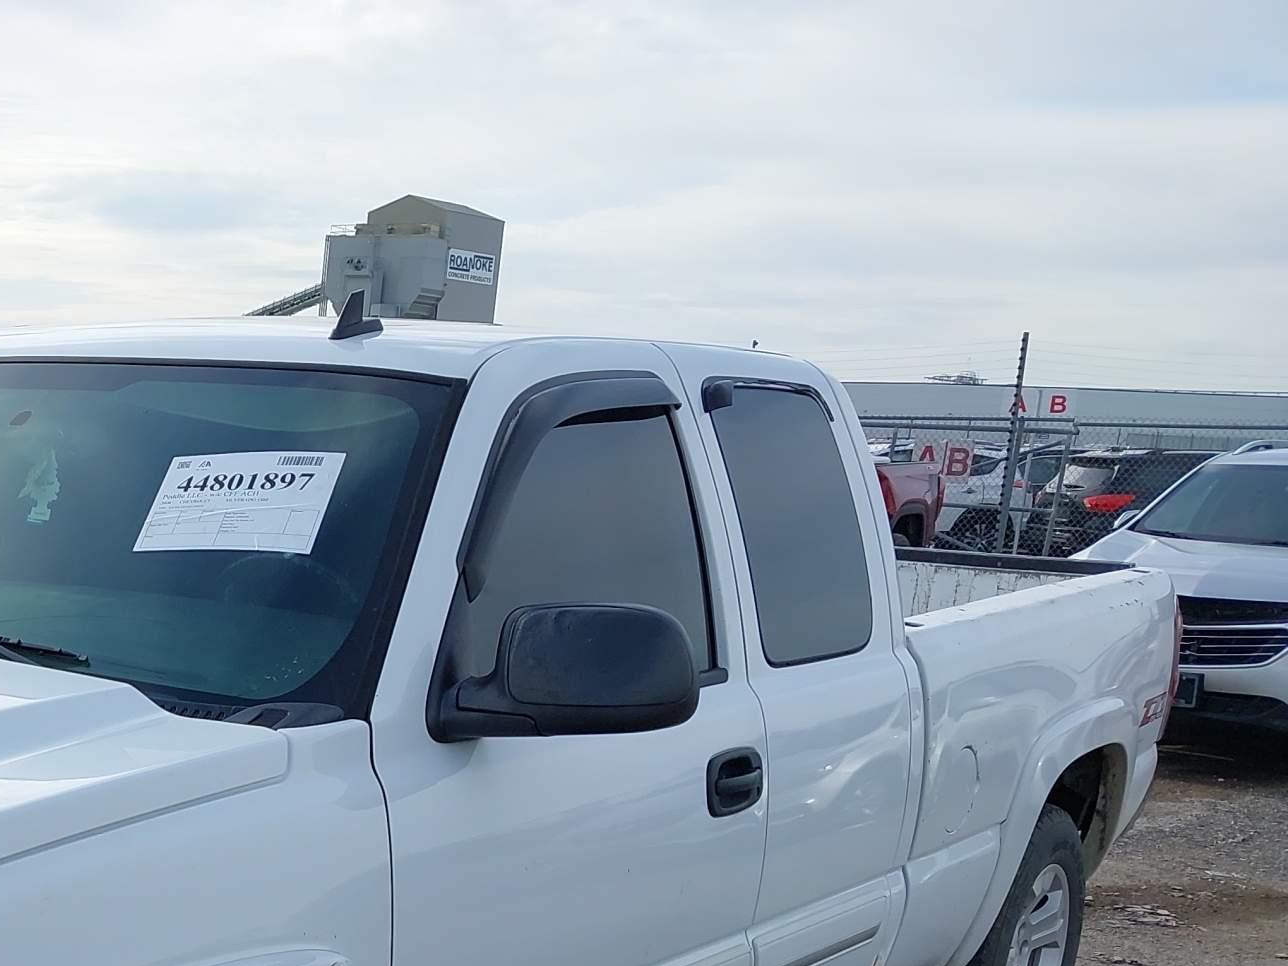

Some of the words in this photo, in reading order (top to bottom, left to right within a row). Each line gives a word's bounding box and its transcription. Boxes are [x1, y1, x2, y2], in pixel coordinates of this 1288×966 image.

[449, 254, 494, 272] ROANOKE
[1008, 395, 1026, 412] A
[1049, 395, 1067, 413] B
[945, 448, 969, 476] B
[177, 472, 315, 493] 44801897
